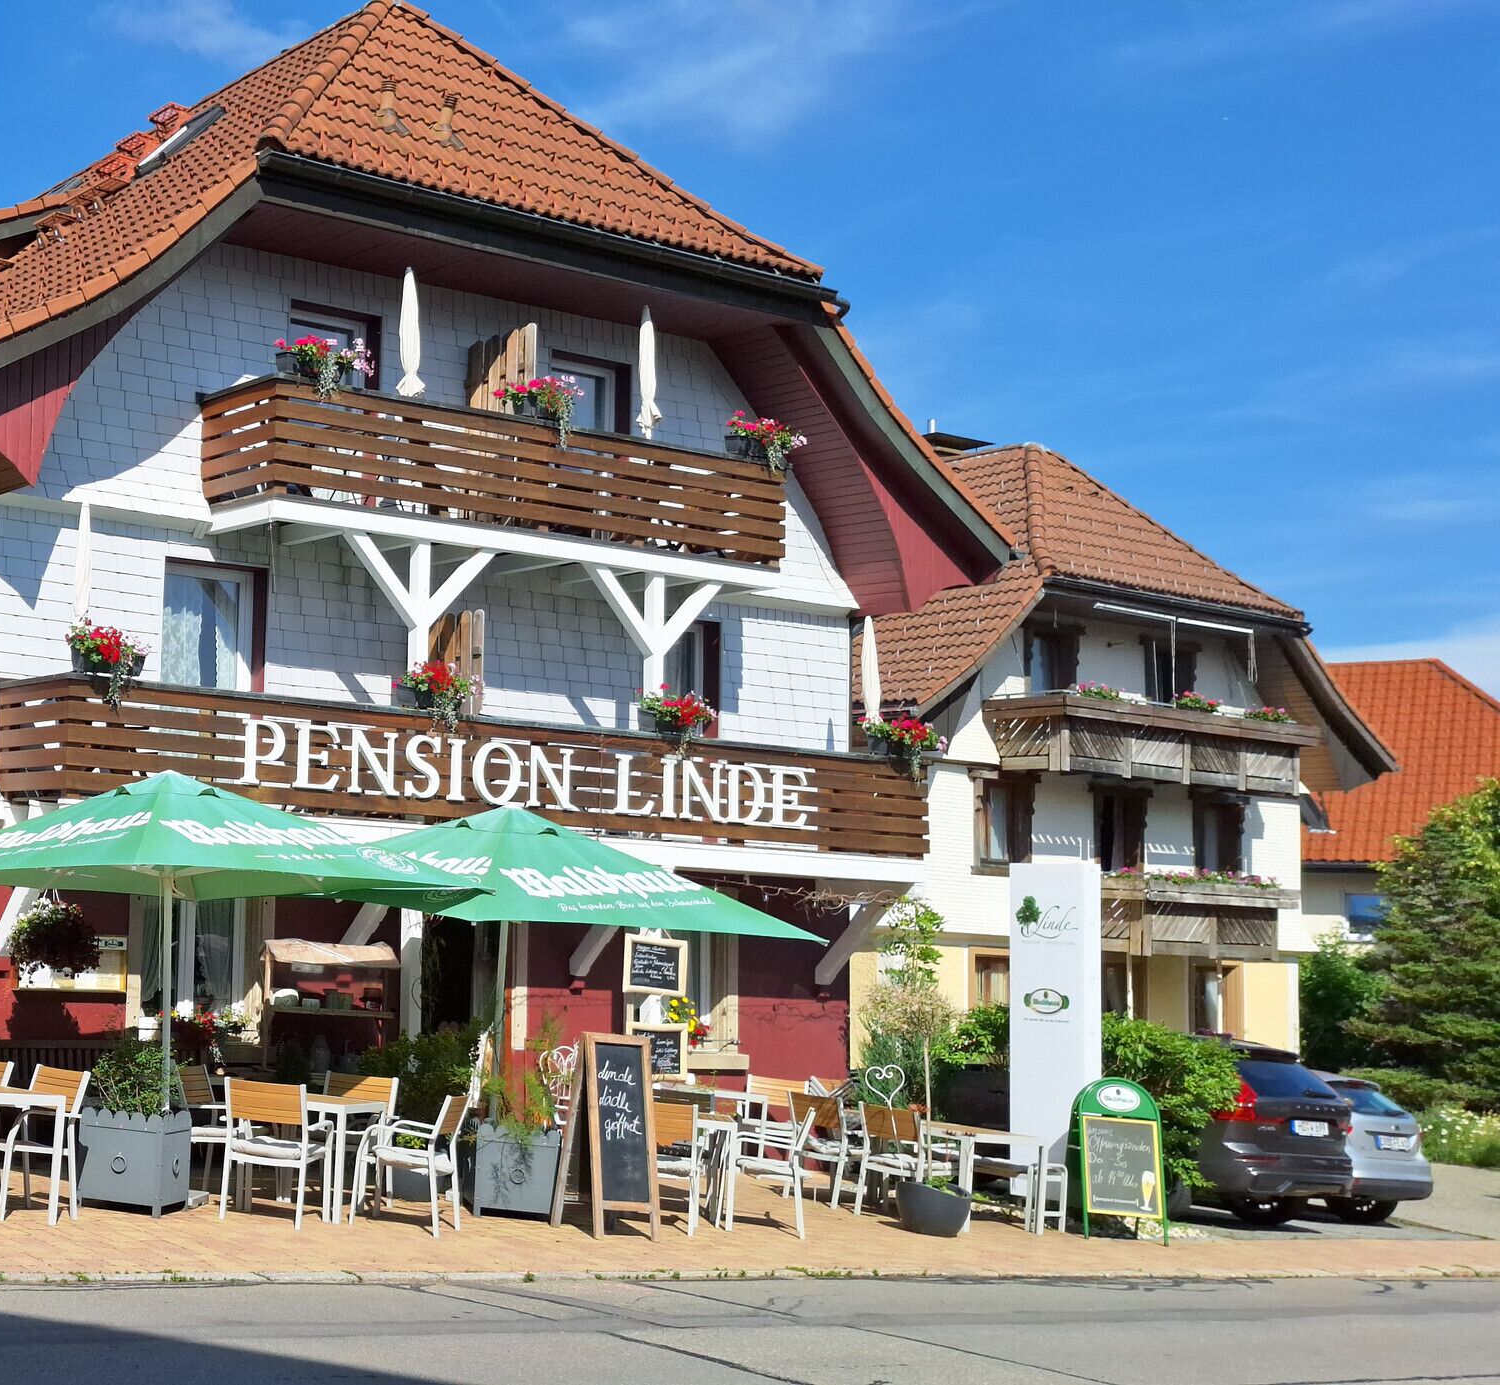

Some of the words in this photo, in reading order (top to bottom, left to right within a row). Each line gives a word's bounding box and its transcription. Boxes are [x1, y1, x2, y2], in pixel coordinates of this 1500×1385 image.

[239, 719, 580, 812] PENSION
[613, 753, 809, 827] LINDE
[1021, 905, 1078, 939] Linde
